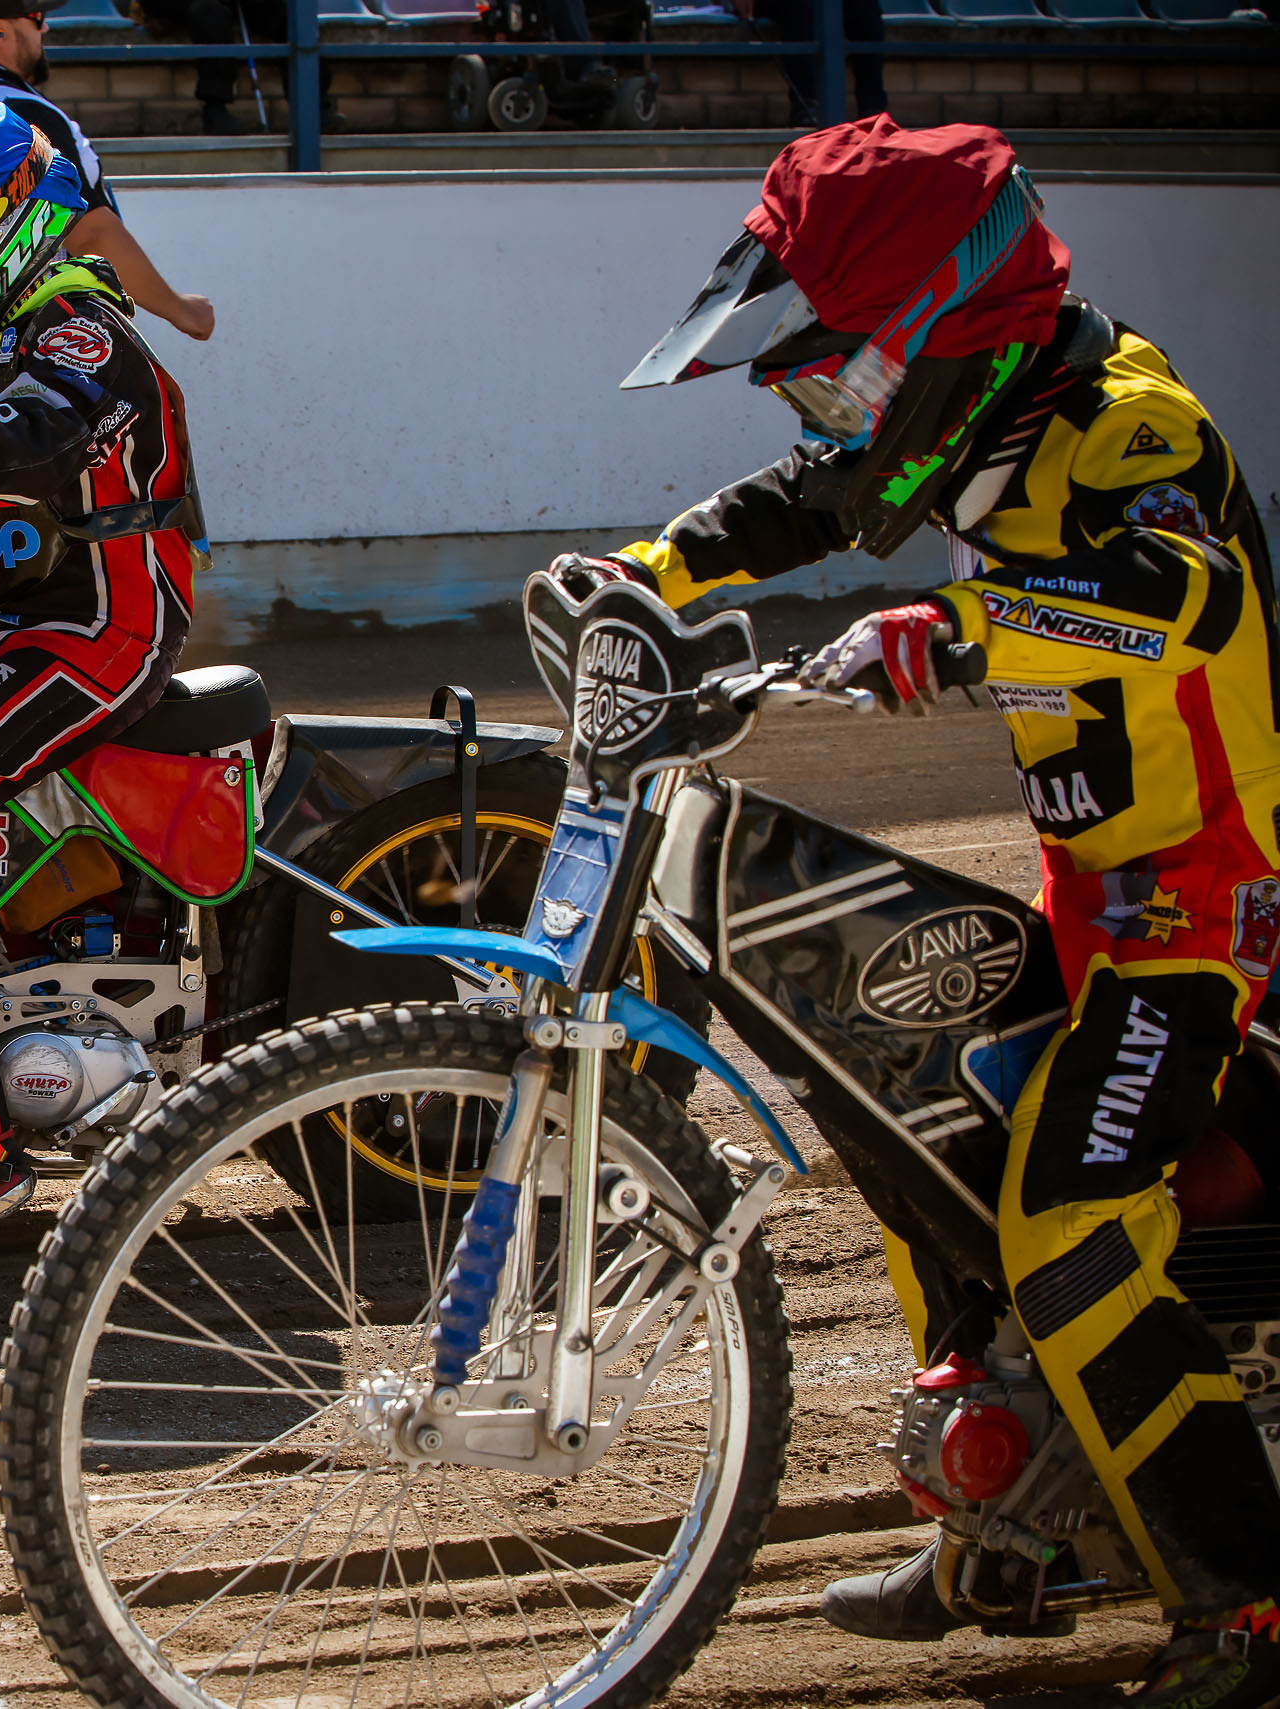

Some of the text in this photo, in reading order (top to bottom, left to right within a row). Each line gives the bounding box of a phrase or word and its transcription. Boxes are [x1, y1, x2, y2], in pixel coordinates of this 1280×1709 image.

[1024, 576, 1102, 600] FACTORY
[586, 632, 643, 682] JAWA
[1041, 700, 1066, 712] 1989
[898, 913, 993, 972] JAWA
[15, 1077, 69, 1090] SHUPA
[1081, 994, 1170, 1164] LATVIJA
